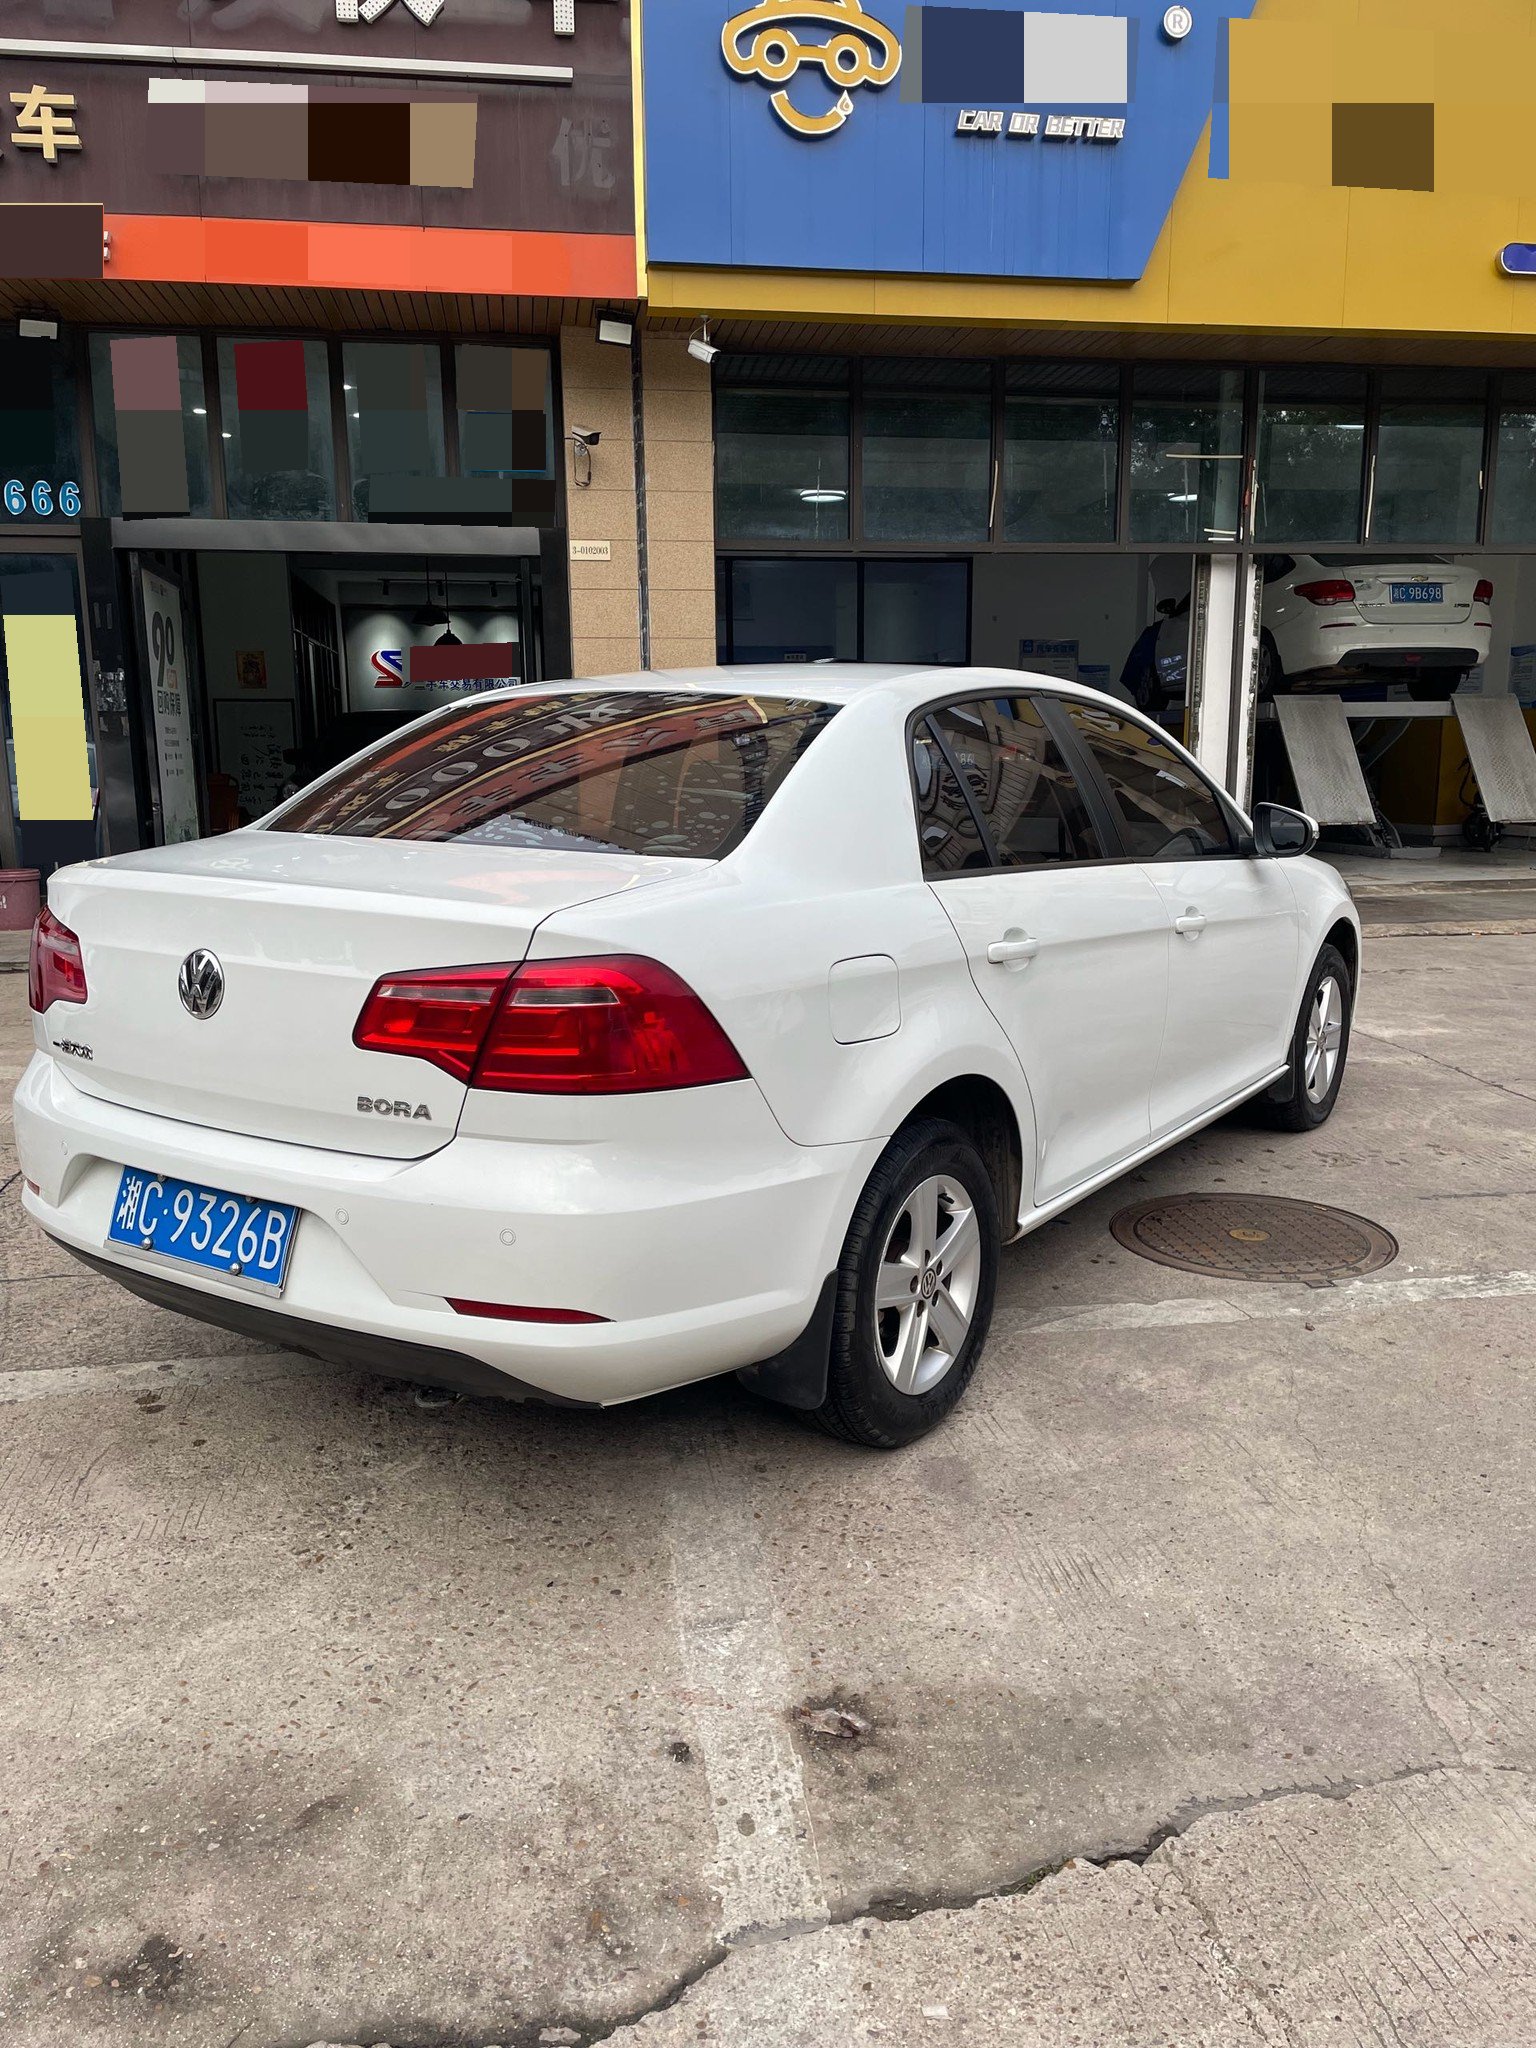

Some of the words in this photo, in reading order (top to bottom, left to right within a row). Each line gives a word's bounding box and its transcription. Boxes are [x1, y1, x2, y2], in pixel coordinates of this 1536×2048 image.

[10, 84, 81, 163] 车
[957, 109, 1004, 132] CAR
[1008, 112, 1041, 135] OR
[1044, 115, 1126, 139] BETTER
[356, 1096, 432, 1121] BORA
